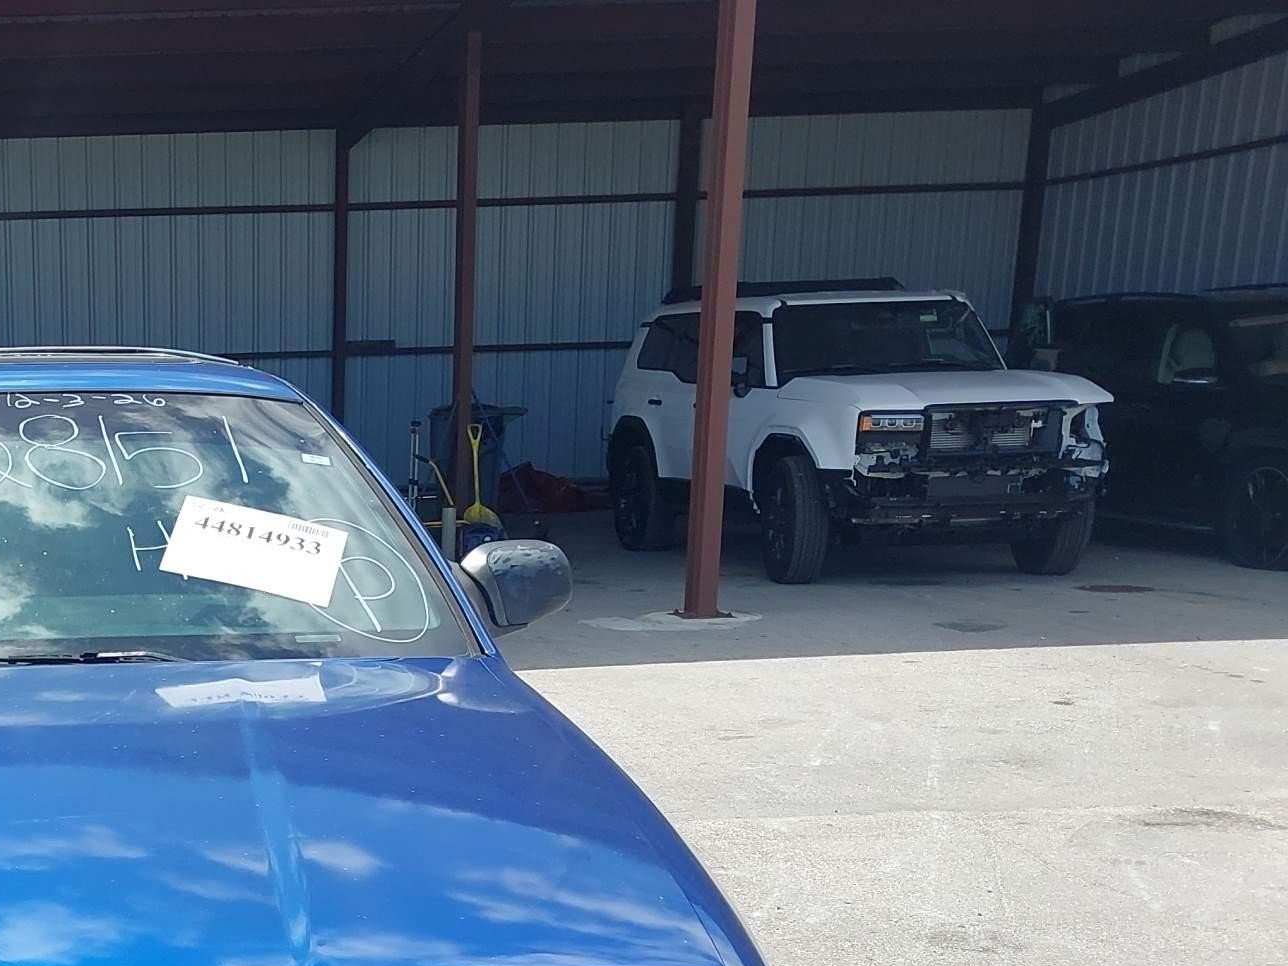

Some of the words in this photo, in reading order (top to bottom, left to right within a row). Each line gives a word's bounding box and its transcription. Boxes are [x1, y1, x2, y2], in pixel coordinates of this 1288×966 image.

[6, 393, 166, 408] 12-3-26
[194, 515, 323, 556] 44814933
[338, 556, 396, 633] P
